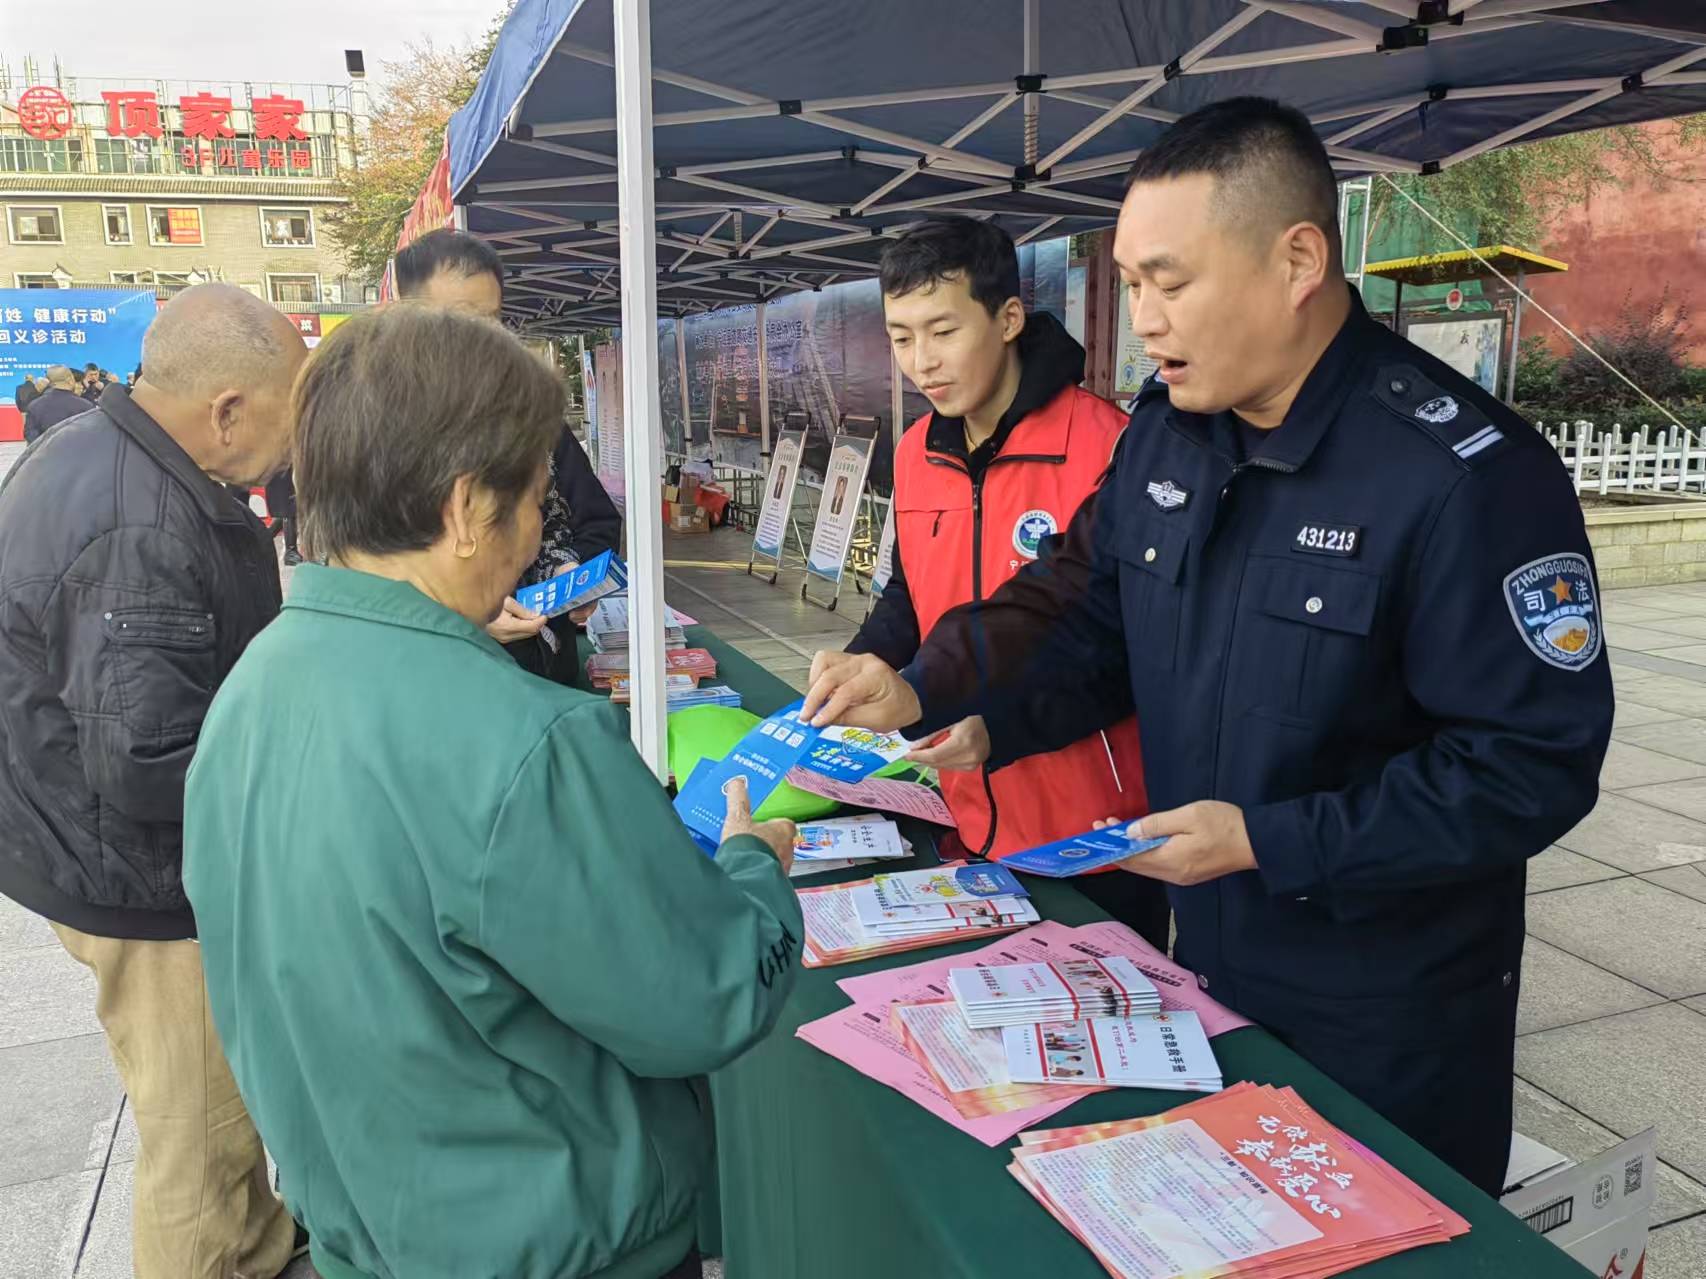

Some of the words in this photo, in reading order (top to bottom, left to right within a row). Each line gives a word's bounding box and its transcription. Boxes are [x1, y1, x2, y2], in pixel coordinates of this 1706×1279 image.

[101, 91, 308, 141] 顶家家
[0, 308, 23, 323] 姓
[1297, 526, 1355, 551] 431213
